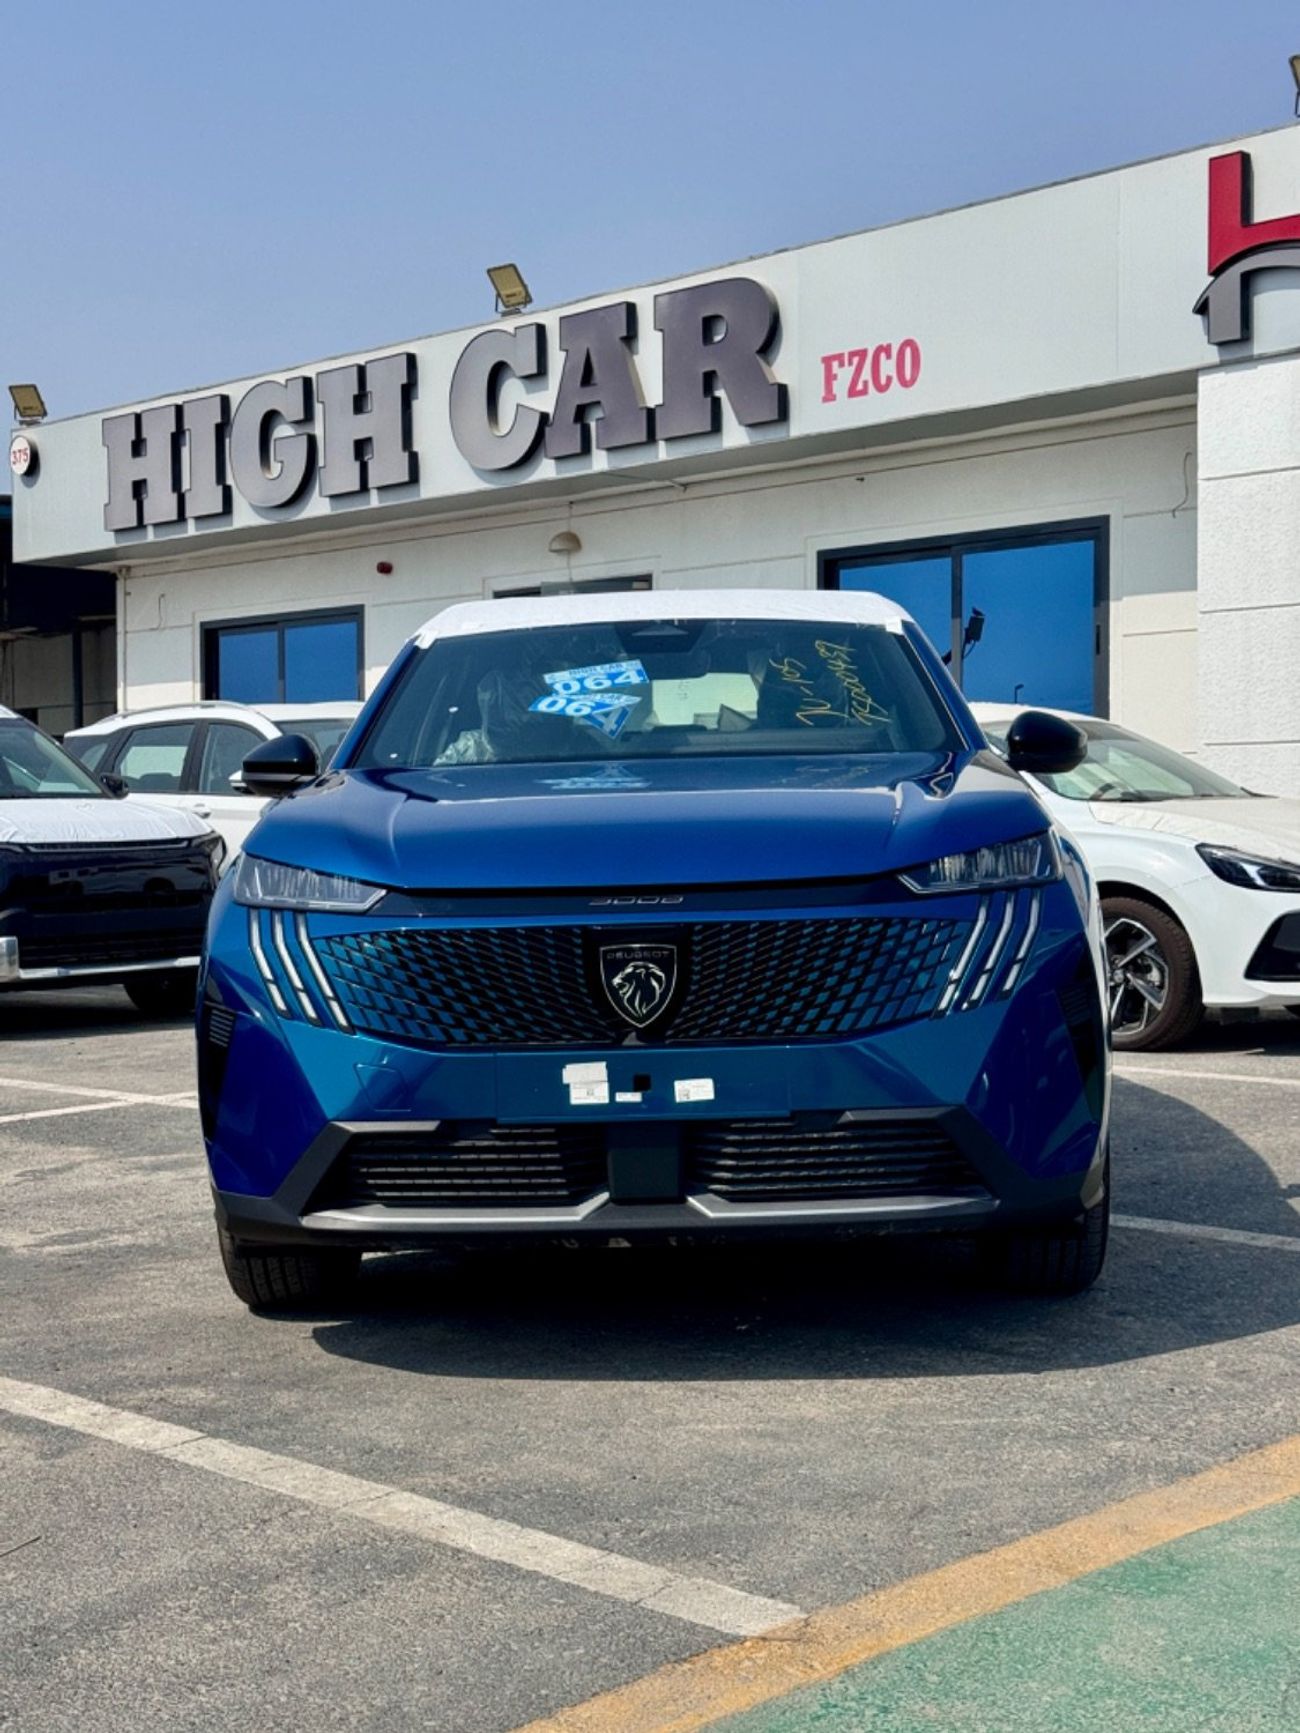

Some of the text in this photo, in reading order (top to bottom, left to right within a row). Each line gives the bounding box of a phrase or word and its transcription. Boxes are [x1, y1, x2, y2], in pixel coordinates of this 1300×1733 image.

[102, 277, 922, 532] HIGH CAR FZCO
[12, 447, 29, 465] 375
[553, 668, 644, 696] 064
